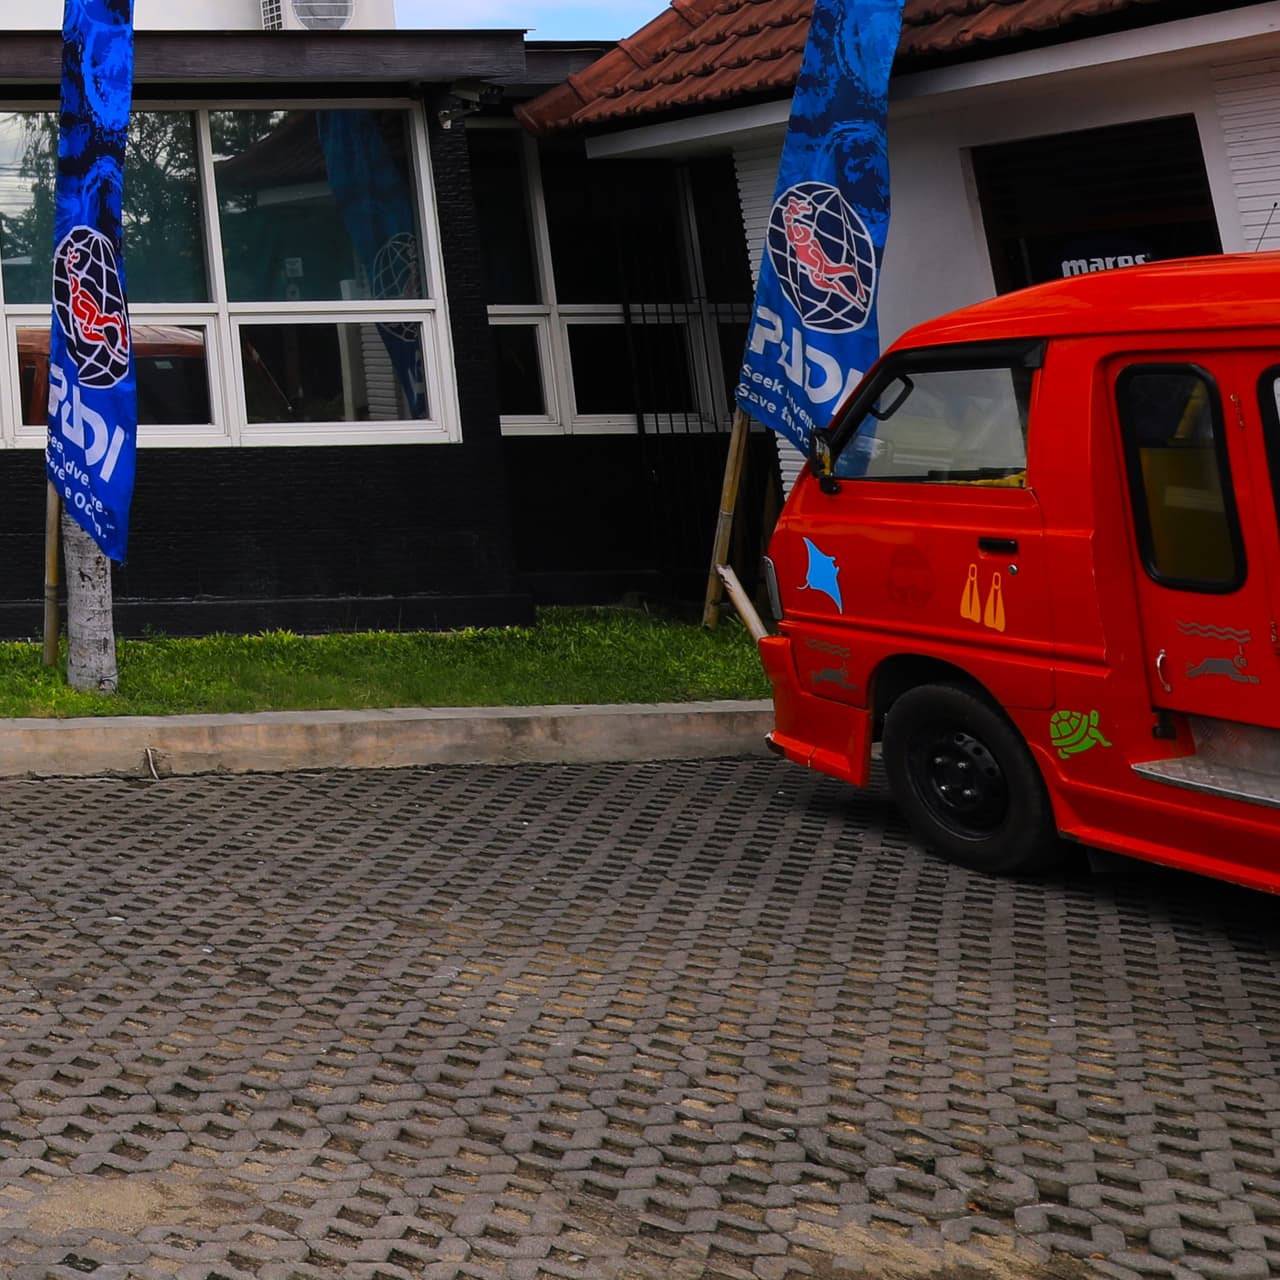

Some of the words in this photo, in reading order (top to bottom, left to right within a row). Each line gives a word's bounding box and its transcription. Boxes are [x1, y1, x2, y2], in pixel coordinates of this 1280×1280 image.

[742, 363, 784, 395] Seek
[749, 305, 864, 416] PADI
[48, 363, 125, 483] PADI
[737, 382, 777, 414] Save
